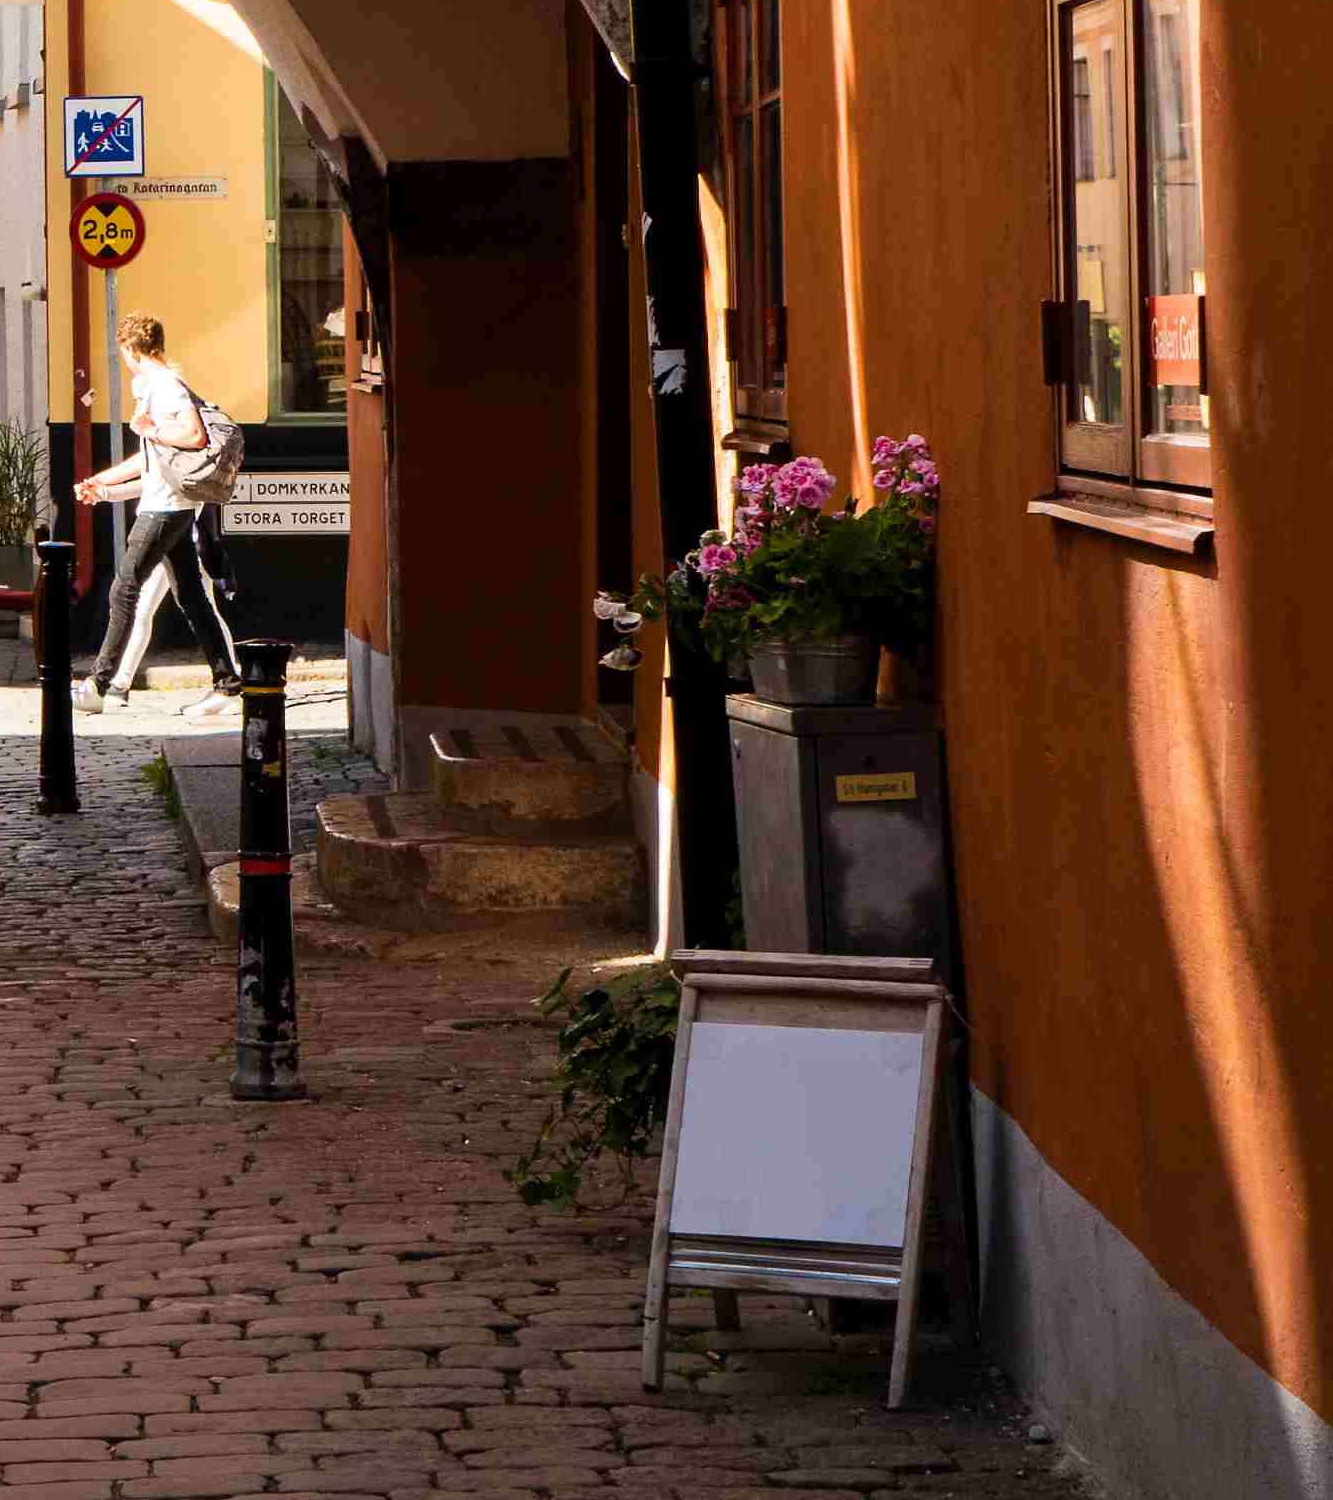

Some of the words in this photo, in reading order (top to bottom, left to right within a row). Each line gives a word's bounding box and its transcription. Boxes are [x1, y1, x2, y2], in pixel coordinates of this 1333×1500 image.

[257, 483, 350, 496] DOMKYRKAN
[234, 512, 282, 525] STORA
[291, 512, 345, 524] TORGET
